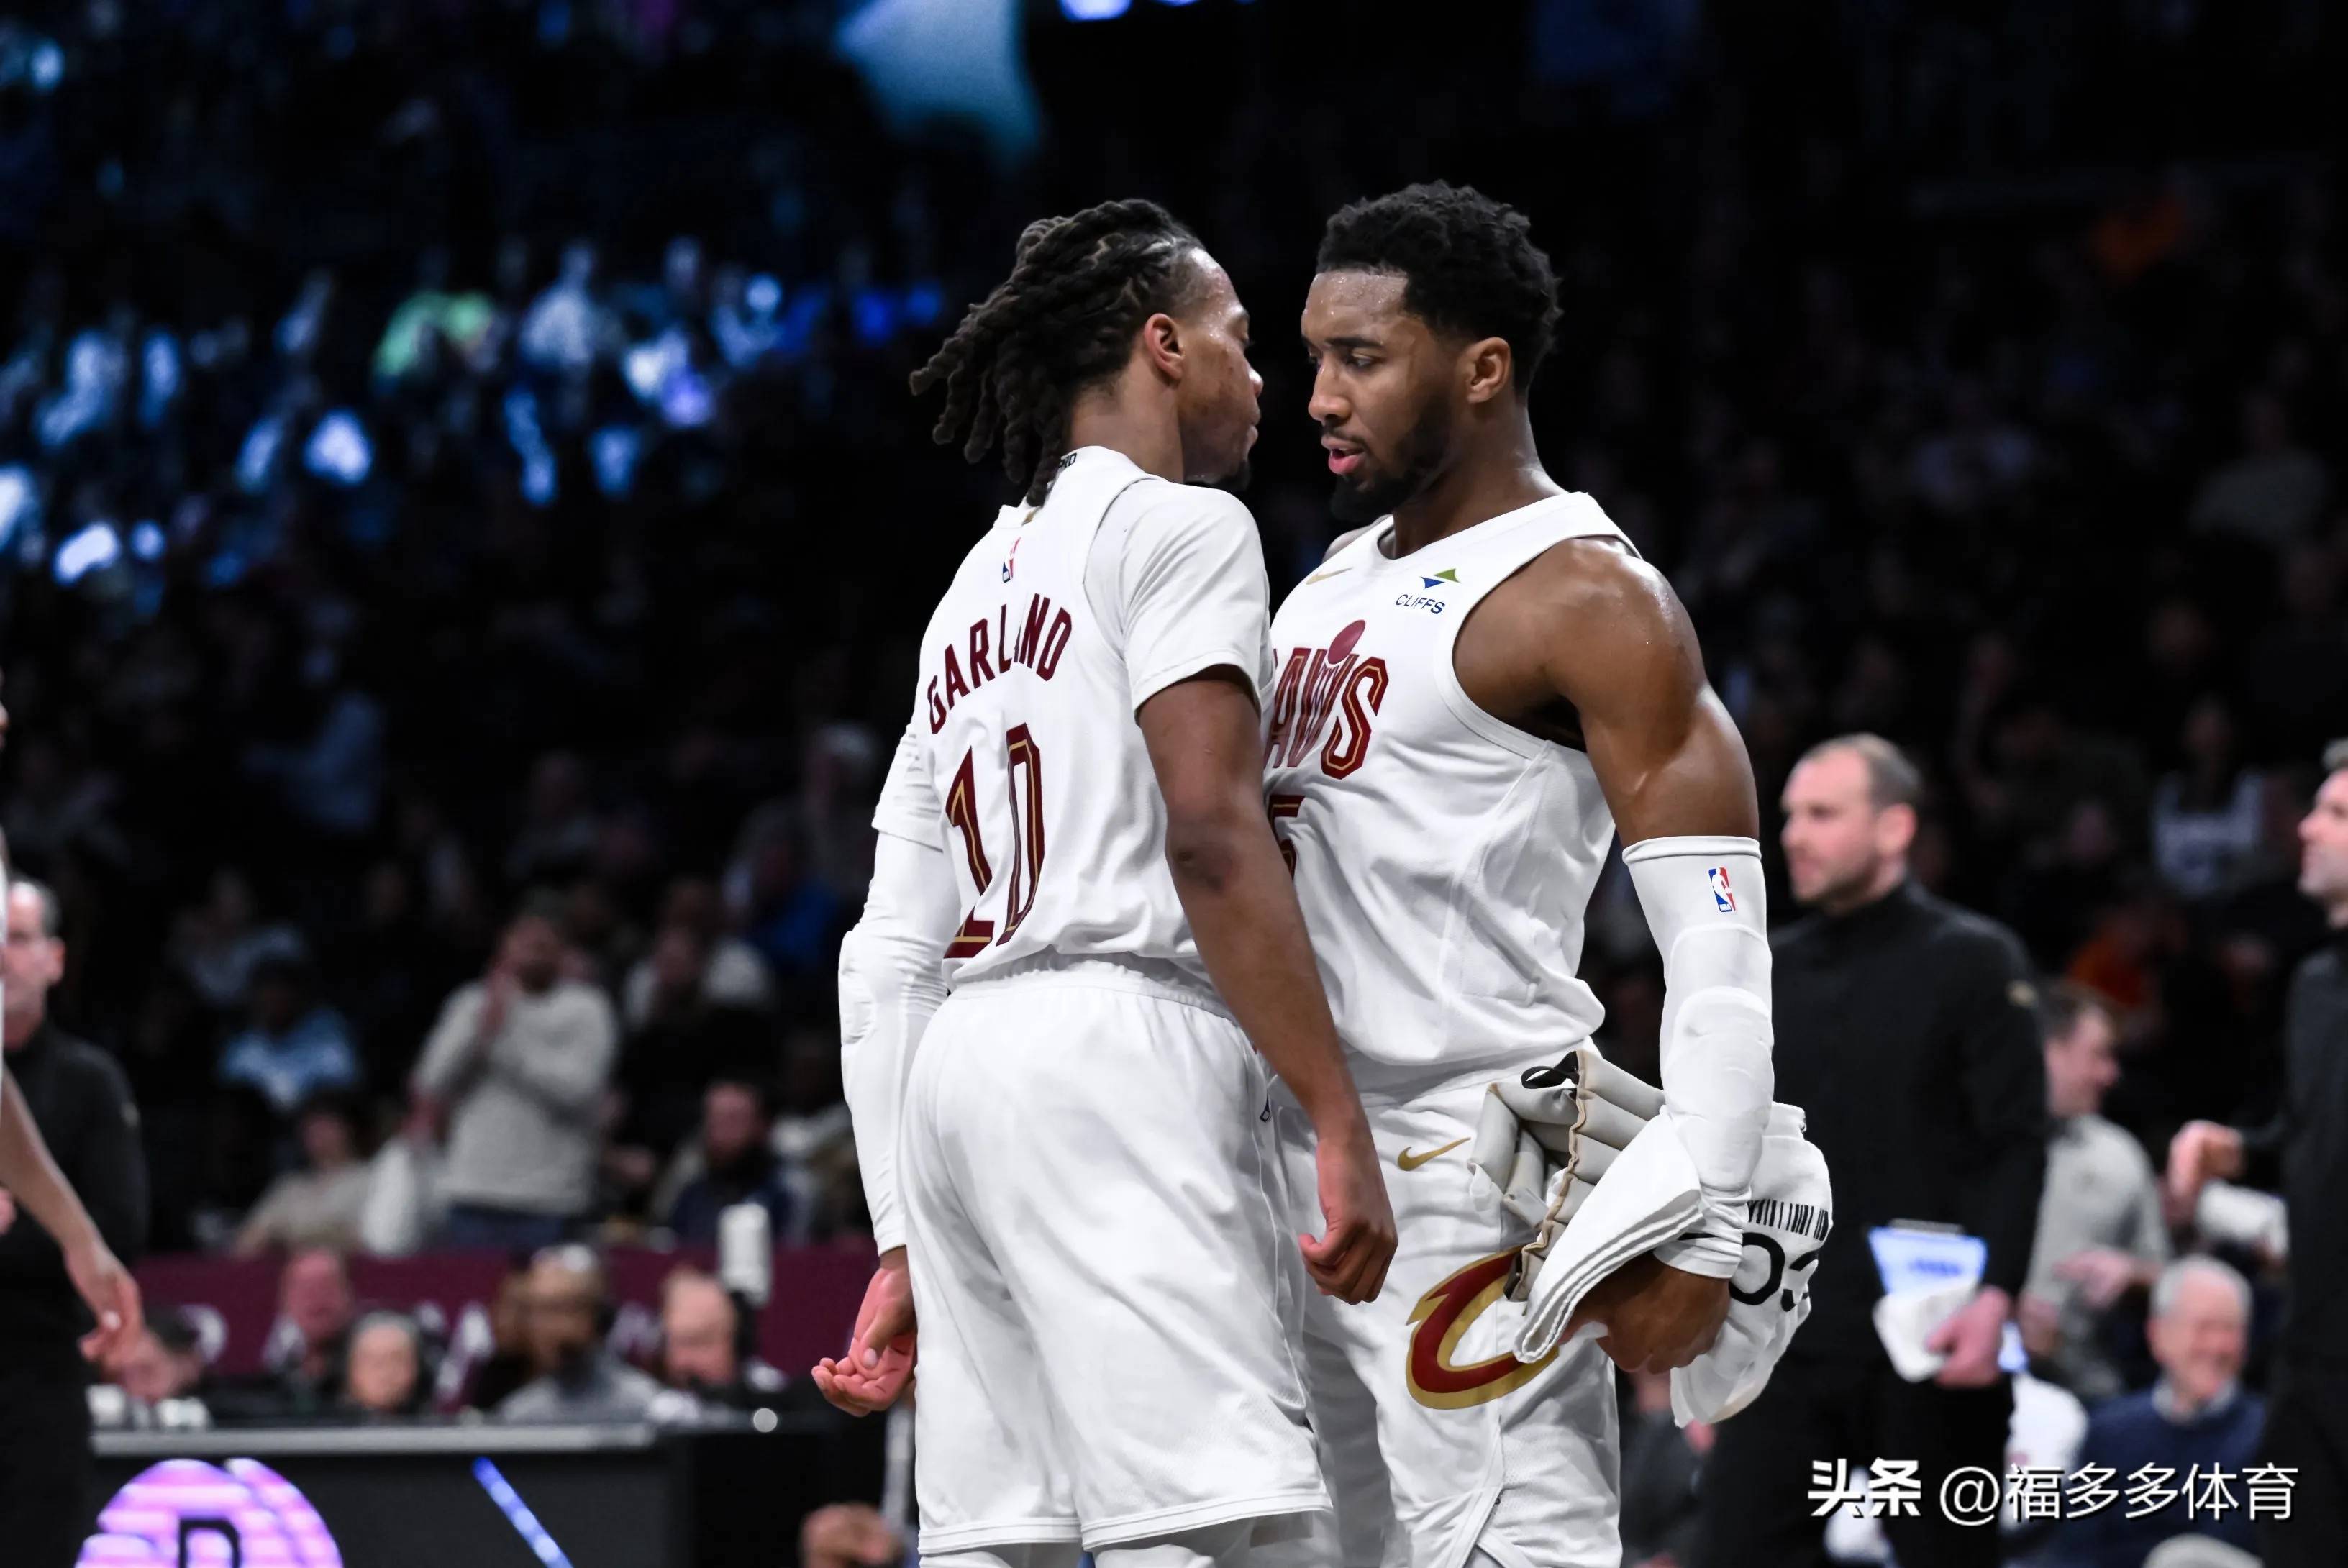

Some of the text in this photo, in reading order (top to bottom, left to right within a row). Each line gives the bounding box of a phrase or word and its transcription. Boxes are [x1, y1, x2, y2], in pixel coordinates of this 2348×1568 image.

[1395, 593, 1446, 614] CLIFFS
[1264, 647, 1389, 780] AVS
[943, 722, 1045, 960] 10
